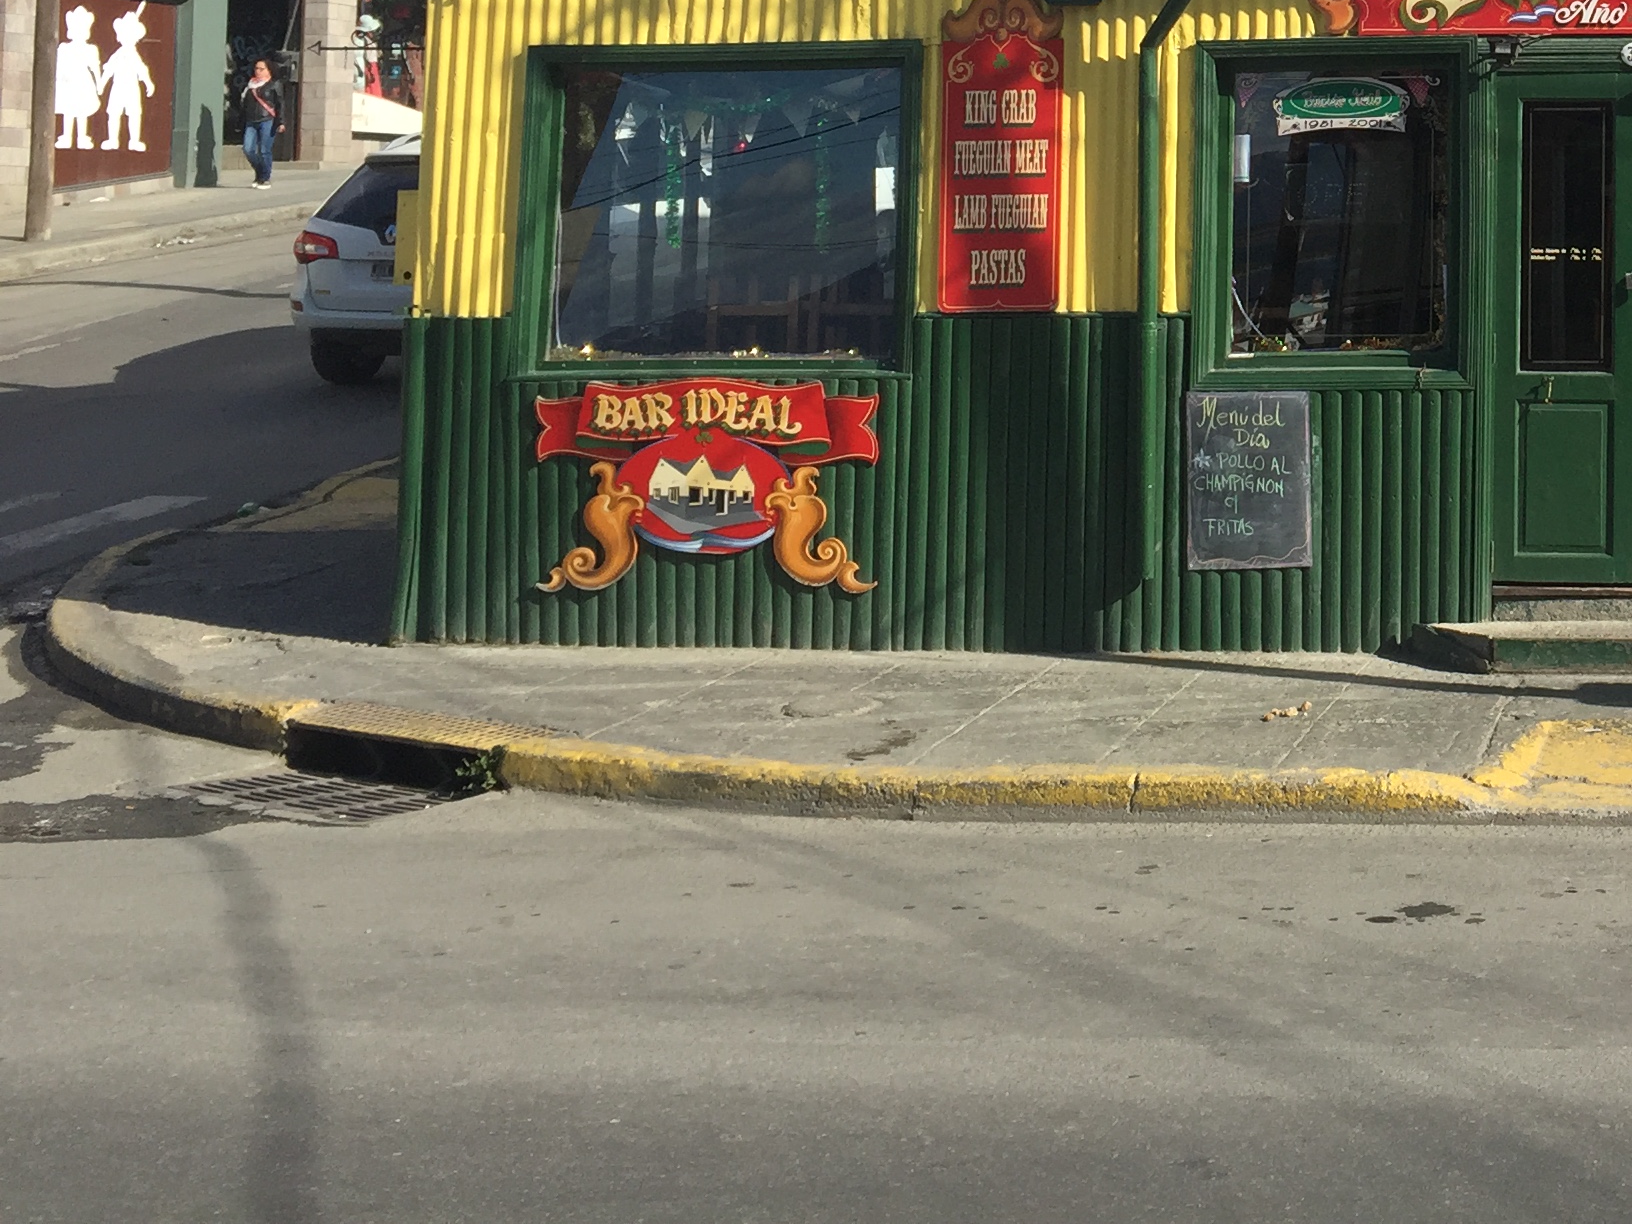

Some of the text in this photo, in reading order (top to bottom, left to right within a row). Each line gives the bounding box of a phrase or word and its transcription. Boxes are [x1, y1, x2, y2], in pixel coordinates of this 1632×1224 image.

[964, 89, 1037, 124] KING CRAB
[1348, 119, 1382, 129] 2001
[954, 139, 1049, 175] FUEGUIAN MEAT
[953, 193, 1049, 229] LAMB FUEGUIAN
[970, 249, 1026, 285] PASTAS
[593, 387, 802, 434] BAR IDEAL
[1197, 396, 1286, 445] Menú del
[1216, 452, 1292, 475] POLLO AL
[1203, 518, 1254, 537] FRITAS
